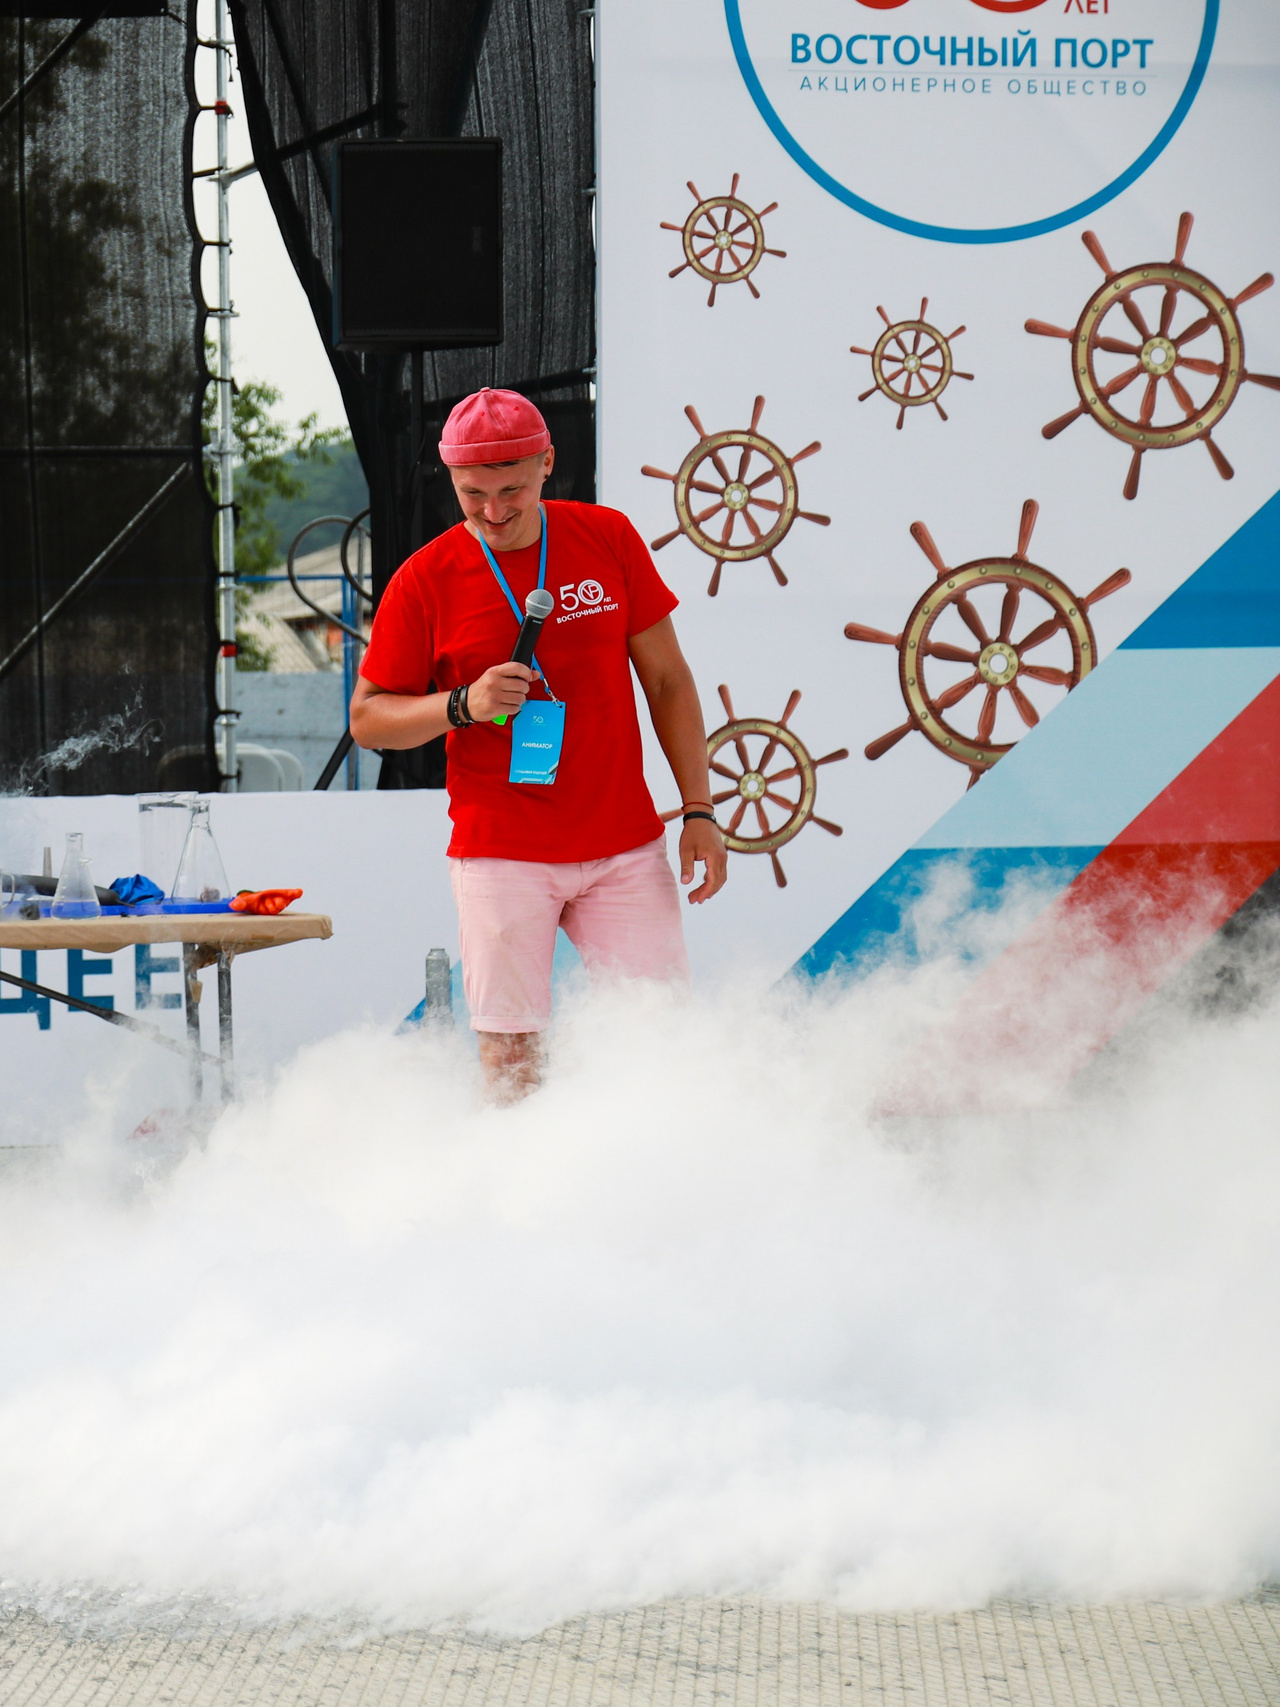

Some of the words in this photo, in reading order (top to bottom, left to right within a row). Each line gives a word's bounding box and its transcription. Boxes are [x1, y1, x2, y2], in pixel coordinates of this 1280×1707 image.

[791, 30, 1038, 68] ВОСТОЧНЫЙ
[1054, 38, 1154, 69] ПОРТ
[800, 76, 992, 94] АКЦИОНЕРНОЕ
[1007, 79, 1147, 97] ОБЩЕСТВО
[556, 605, 602, 624] ВОСТОЧНЫЙ
[603, 603, 619, 612] ПОРТ
